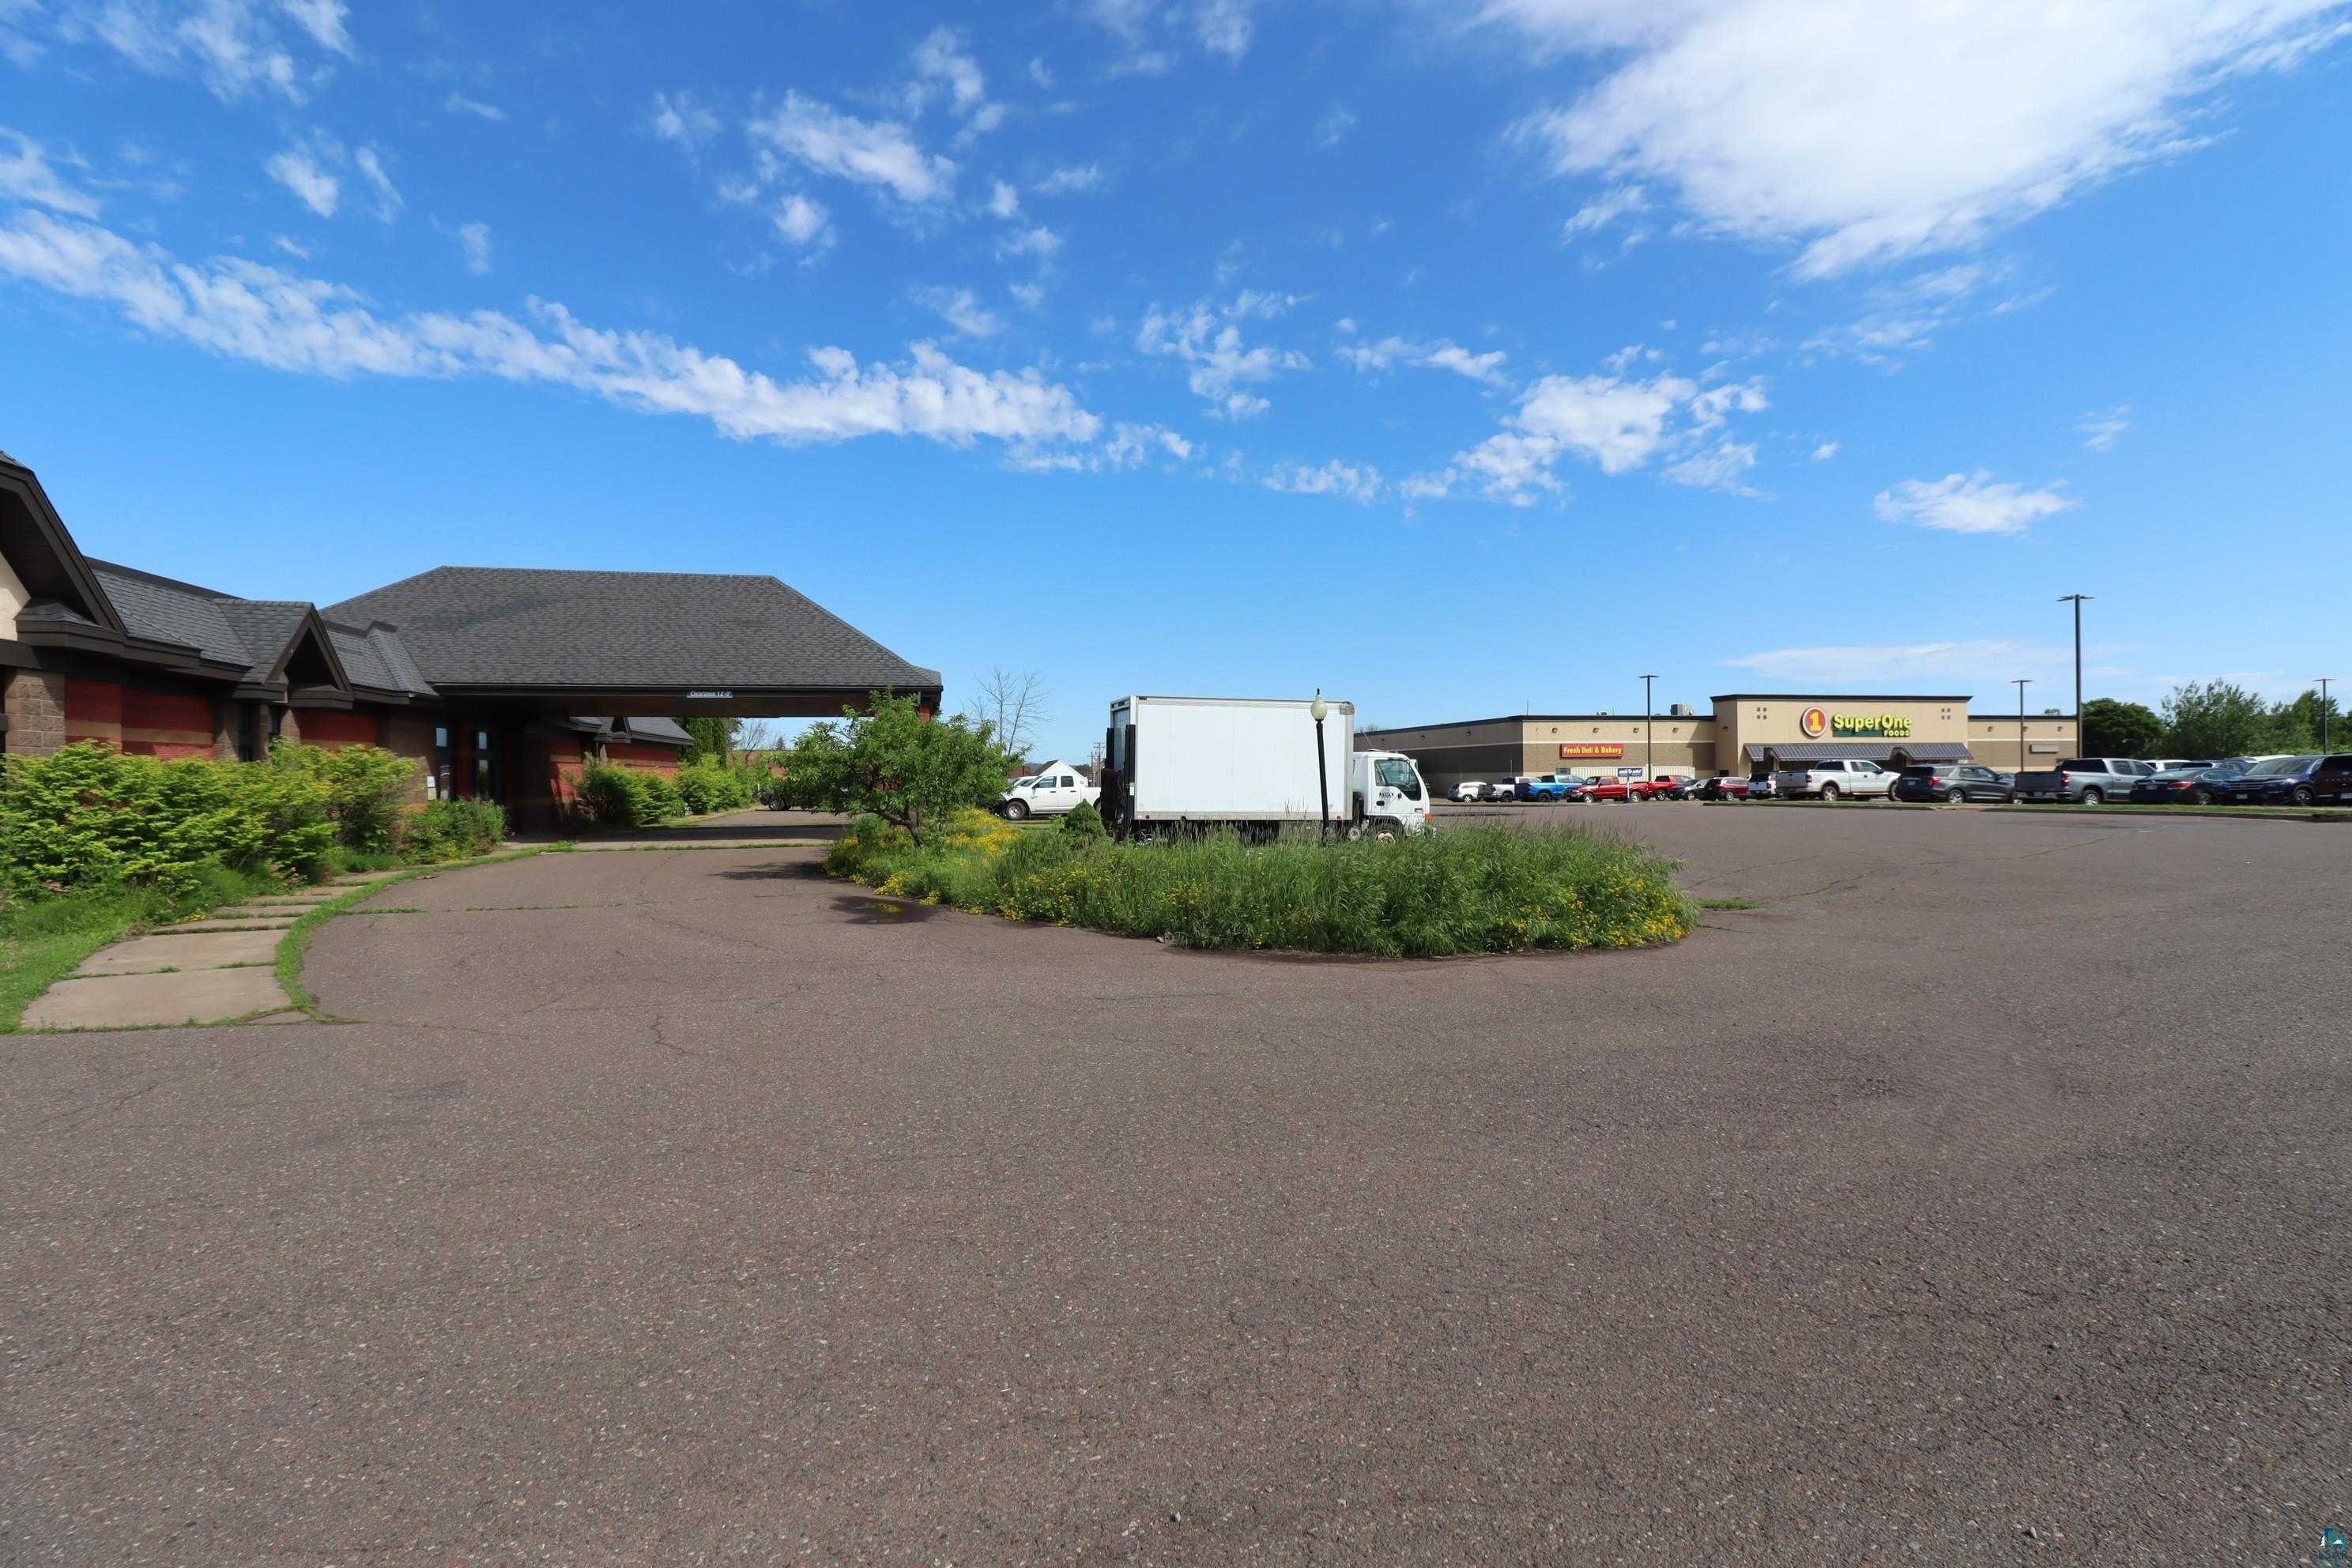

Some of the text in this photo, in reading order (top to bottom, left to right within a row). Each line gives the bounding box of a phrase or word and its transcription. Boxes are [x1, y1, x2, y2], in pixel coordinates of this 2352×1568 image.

[1810, 711, 1822, 732] 1
[1834, 714, 1912, 732] SuperOne
[1601, 746, 1622, 755] Bakery
